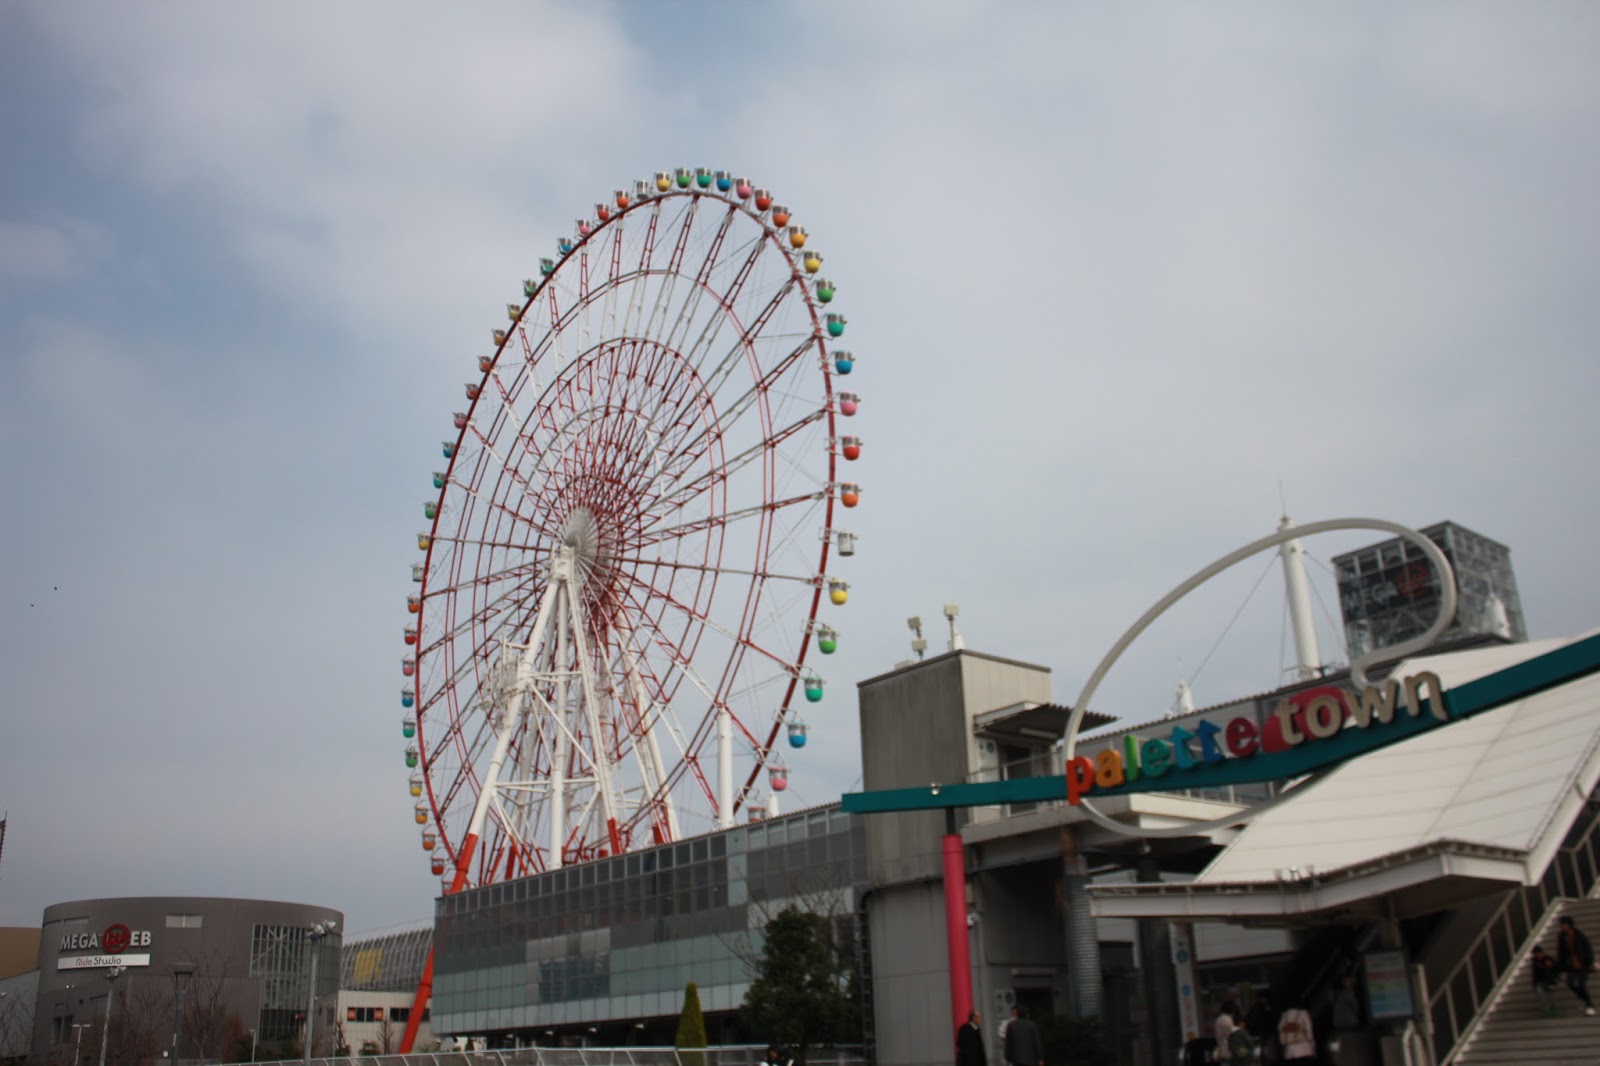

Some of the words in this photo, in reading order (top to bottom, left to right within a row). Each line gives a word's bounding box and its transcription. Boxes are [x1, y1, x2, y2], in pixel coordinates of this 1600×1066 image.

[1066, 718, 1259, 805] palette
[1275, 670, 1448, 746] town
[60, 932, 98, 950] MEGA
[93, 956, 122, 966] Studio
